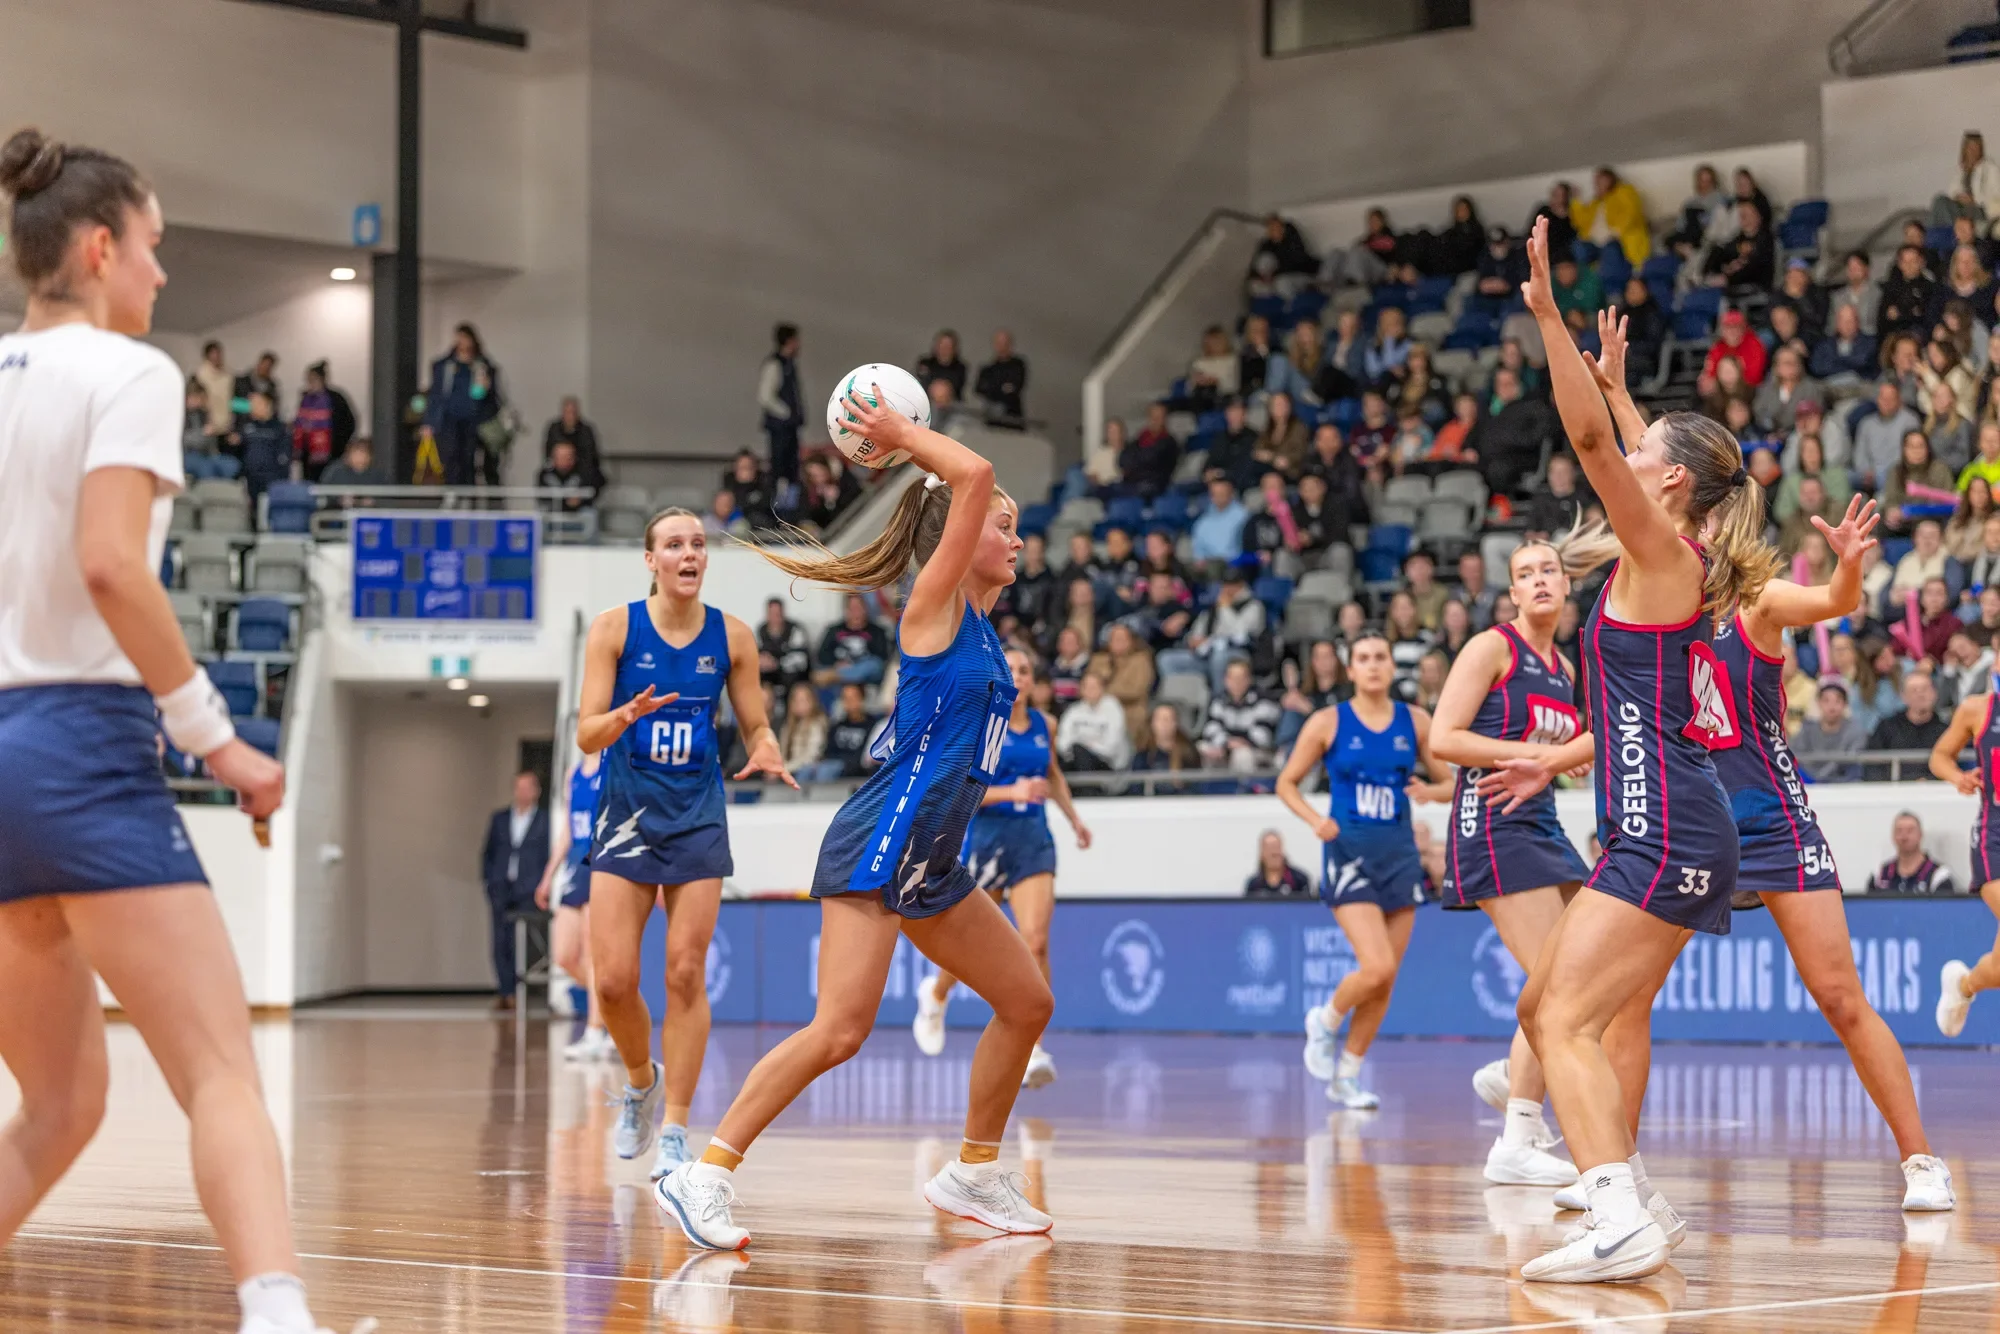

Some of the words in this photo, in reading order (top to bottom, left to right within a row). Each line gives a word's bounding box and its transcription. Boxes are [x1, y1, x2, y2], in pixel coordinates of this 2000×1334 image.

[850, 437, 876, 464] ILBE
[649, 720, 692, 766] GD
[1525, 704, 1577, 745] WD
[1619, 701, 1649, 838] GEELONG
[1764, 719, 1812, 823] GEELONG
[1355, 783, 1395, 820] WD
[1460, 767, 1483, 838] GEELO
[1803, 844, 1835, 876] 54
[1677, 867, 1712, 897] 33
[1784, 938, 1921, 1014] CARS
